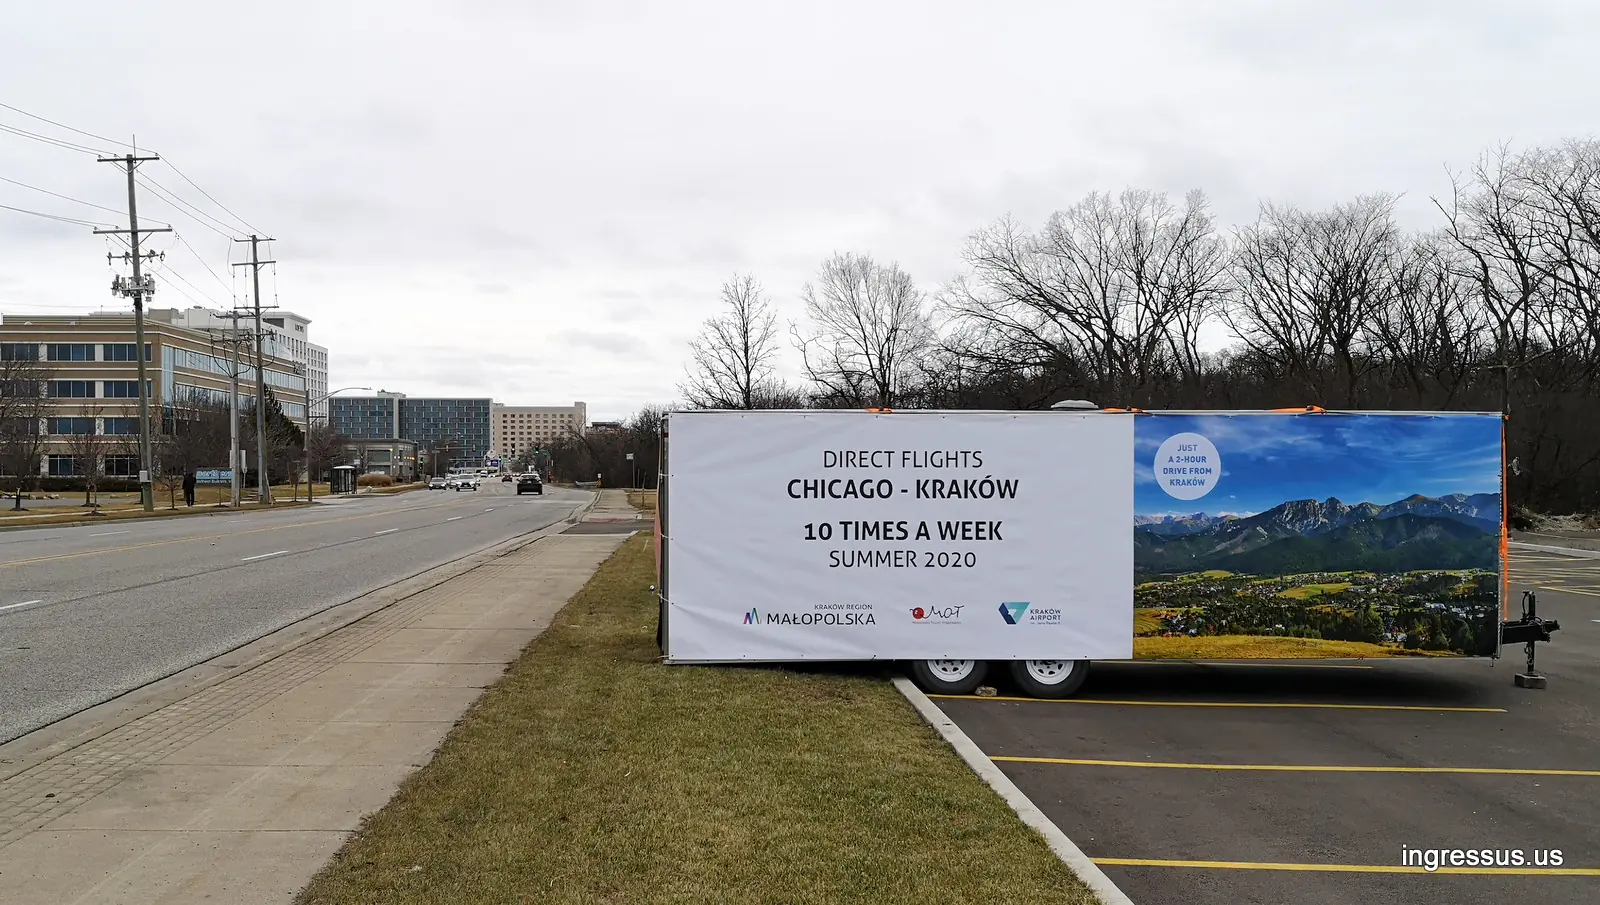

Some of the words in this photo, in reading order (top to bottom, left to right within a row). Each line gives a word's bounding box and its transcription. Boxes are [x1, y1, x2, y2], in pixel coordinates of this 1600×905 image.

[1177, 444, 1198, 452] JUST
[823, 450, 895, 468] DIRECT
[902, 450, 983, 468] FLIGHTS
[1168, 455, 1175, 463] A
[1176, 455, 1207, 463] 2-HOUR
[1163, 467, 1187, 475] DRIVE
[1189, 467, 1212, 475] FROM
[787, 479, 894, 499] CHICAGO
[916, 475, 1019, 499] KRAKÓW
[1169, 476, 1205, 486] KRAKÓW
[804, 522, 833, 541] 10
[839, 521, 909, 541] TIMES
[915, 521, 931, 541] A
[937, 521, 1003, 541] WEEK
[829, 550, 917, 568] SUMMER
[924, 552, 977, 568] 2020
[766, 613, 876, 626] MAŁOPOLSKA
